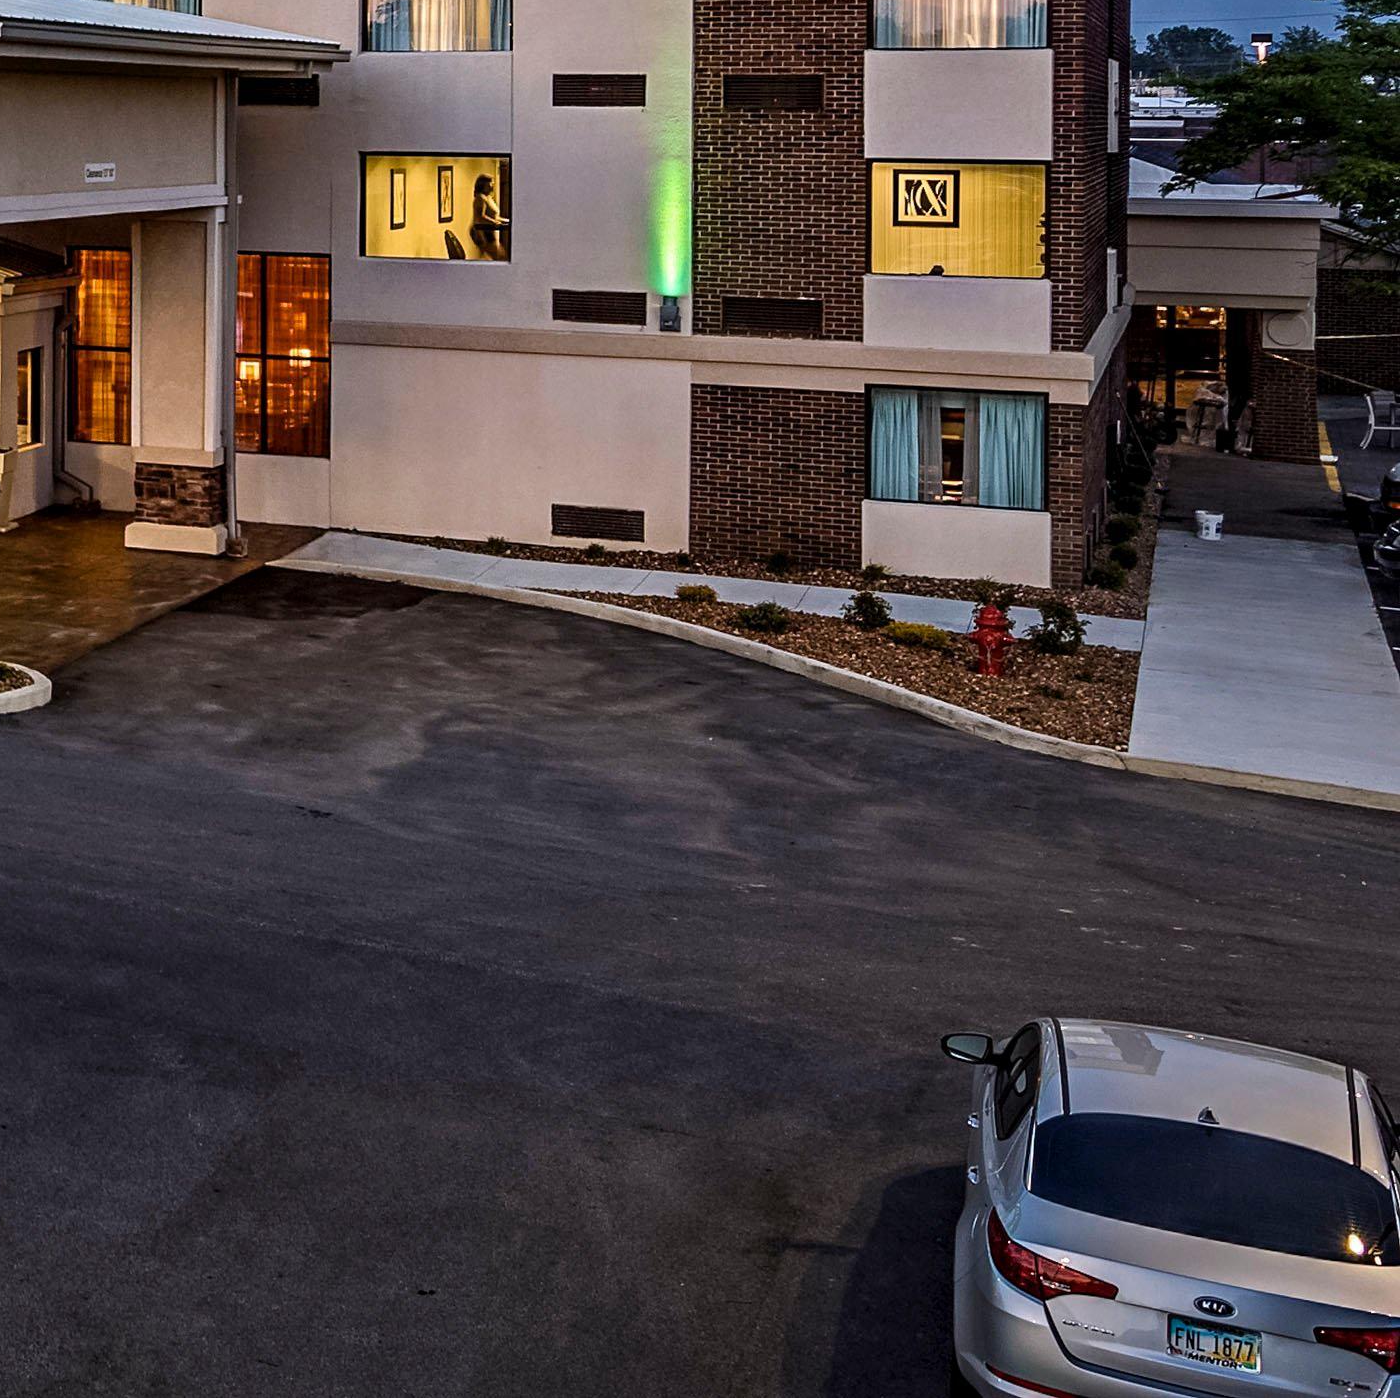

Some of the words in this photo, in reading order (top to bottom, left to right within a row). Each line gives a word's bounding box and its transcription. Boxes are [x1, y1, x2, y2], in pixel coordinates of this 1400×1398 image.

[1202, 1299, 1227, 1314] KIA
[1175, 1326, 1206, 1353] FNL
[1210, 1334, 1254, 1362] 1877
